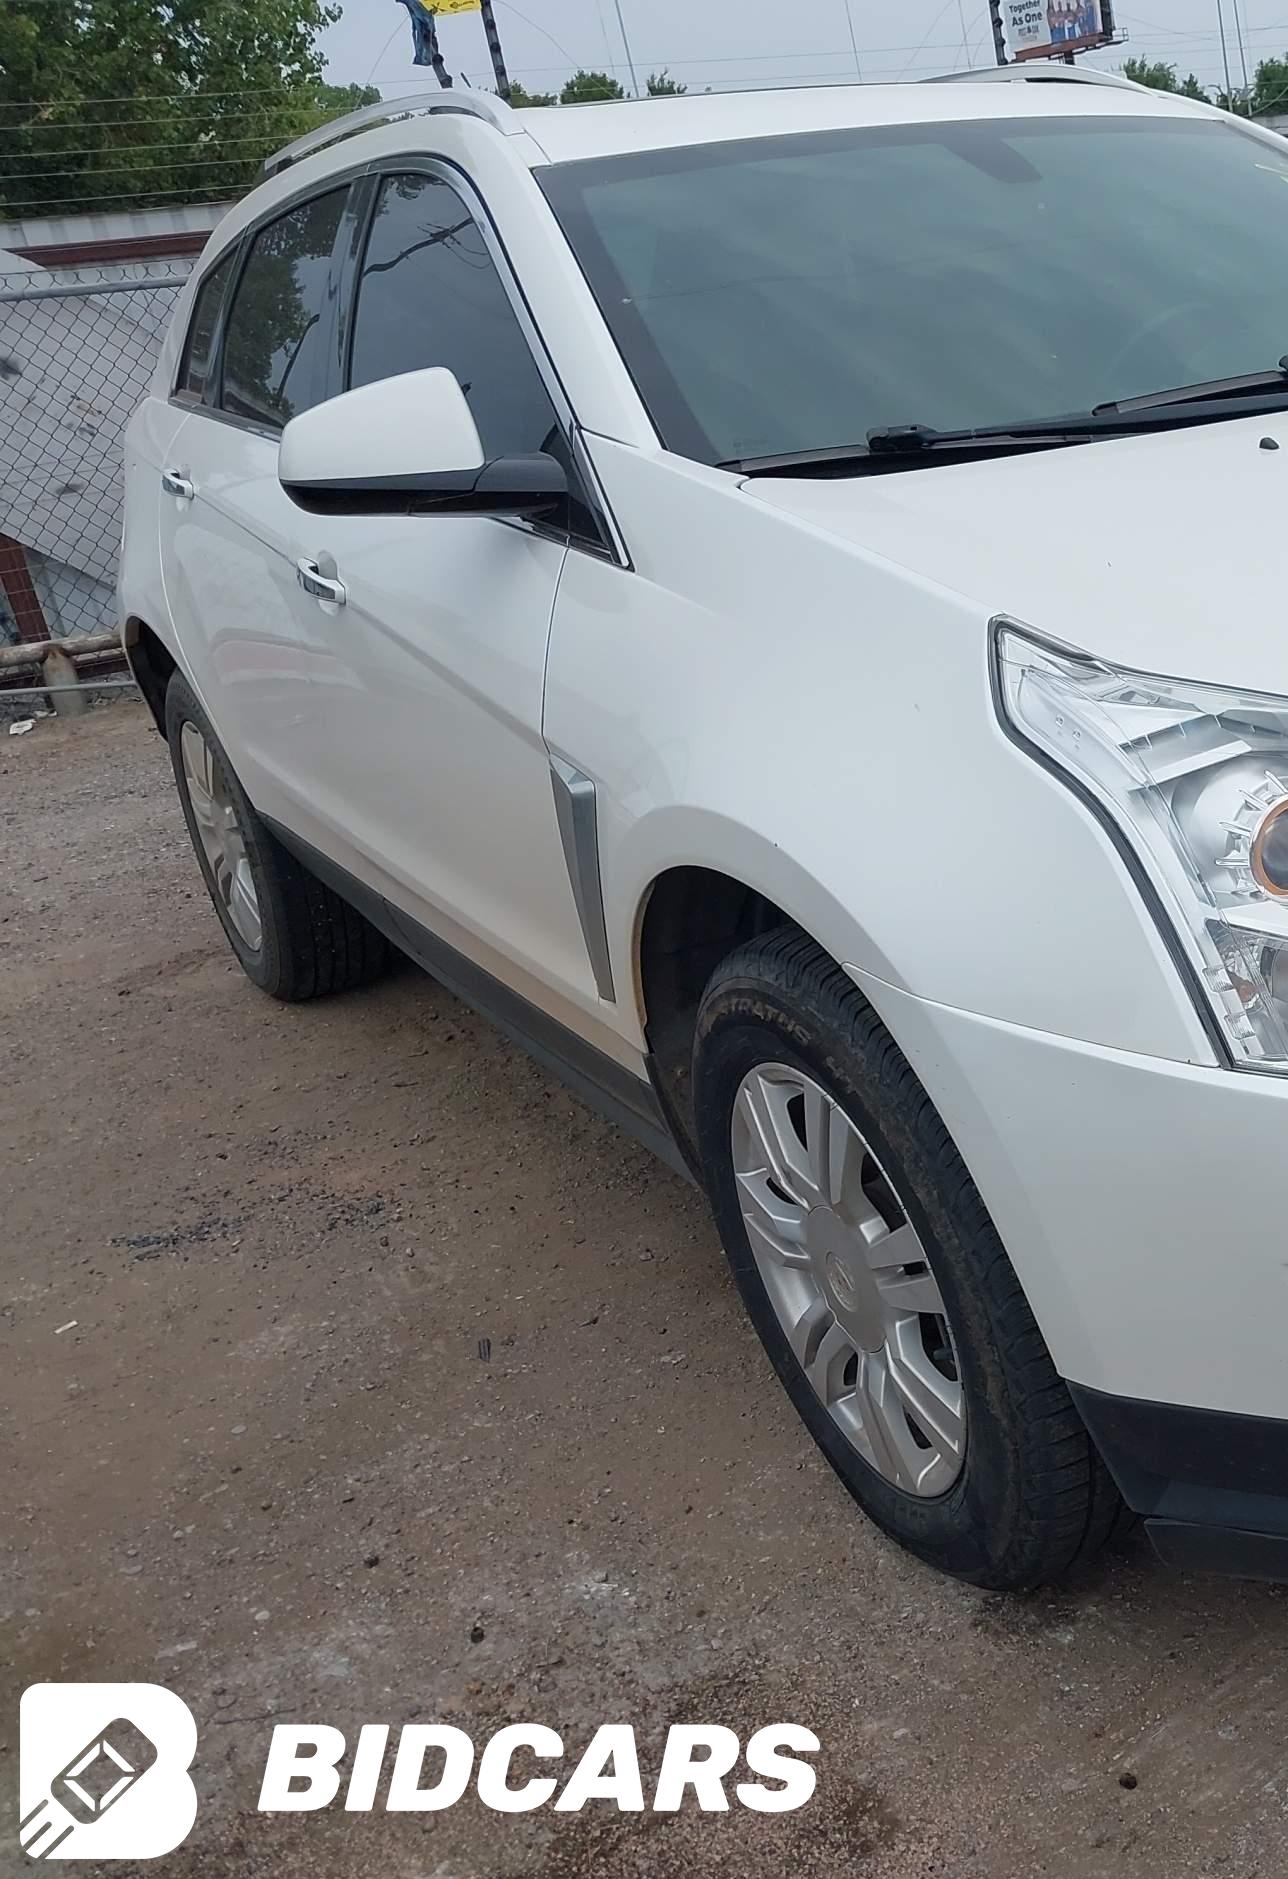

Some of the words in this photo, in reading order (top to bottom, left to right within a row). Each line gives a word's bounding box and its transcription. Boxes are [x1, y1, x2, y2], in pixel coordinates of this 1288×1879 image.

[1009, 0, 1040, 13] Together
[1012, 16, 1024, 27] As
[1025, 11, 1042, 23] One
